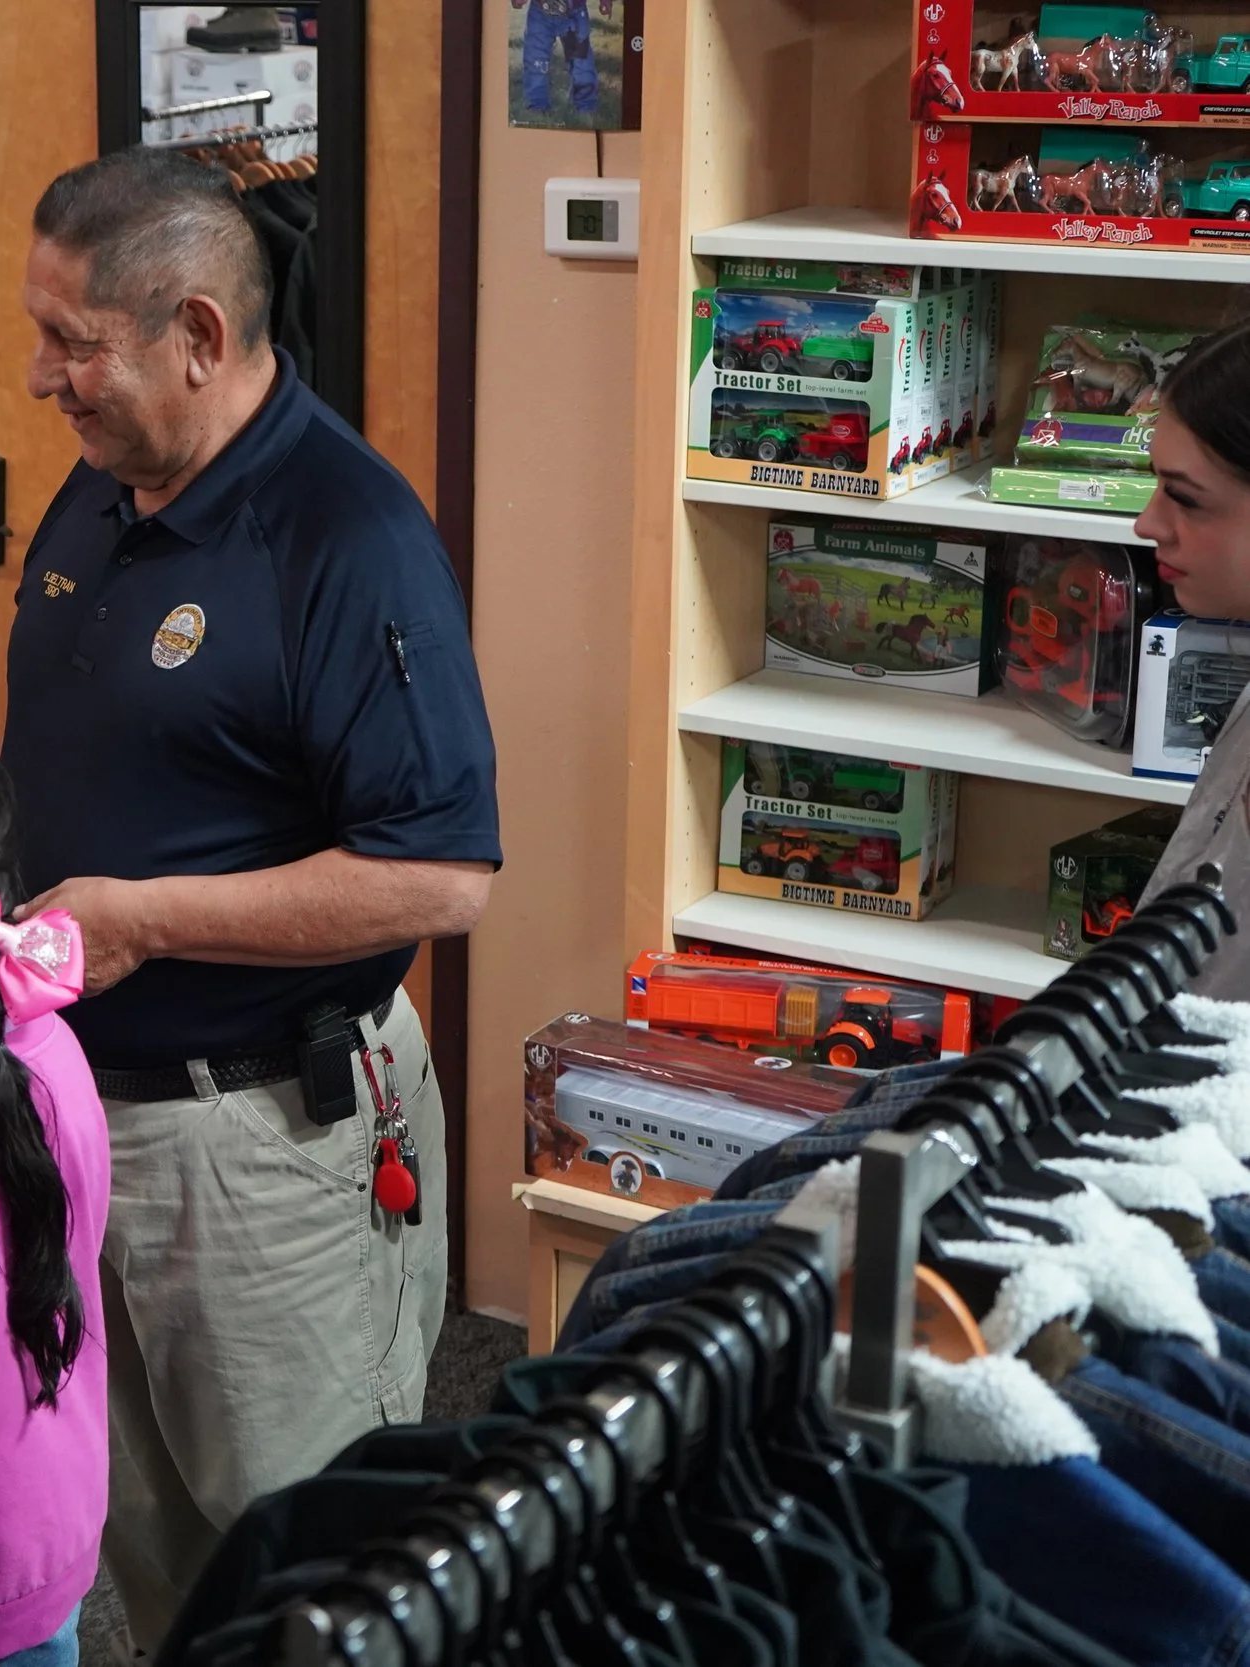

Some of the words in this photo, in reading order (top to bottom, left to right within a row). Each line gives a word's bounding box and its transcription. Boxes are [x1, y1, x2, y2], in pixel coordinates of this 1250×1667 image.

[1058, 96, 1110, 120] Valley
[1109, 98, 1163, 122] Ranch
[1052, 218, 1102, 242] Valley
[1102, 221, 1153, 245] Ranch
[723, 262, 771, 279] Tractor
[775, 265, 797, 280] Set
[924, 330, 933, 385] Tractor
[943, 324, 952, 378] Tractor
[903, 339, 912, 394] Tractor
[714, 371, 771, 390] Tractor
[777, 376, 802, 393] Set
[805, 384, 836, 394] top-level
[838, 386, 854, 395] farm
[750, 465, 803, 486] BIGTIME
[811, 472, 880, 496] BARNYARD
[825, 535, 861, 550] Farm
[864, 540, 926, 557] Animals
[745, 796, 802, 816] Tractor
[807, 804, 832, 820] Set
[781, 884, 834, 905] BIGTIME
[842, 894, 911, 917] BARNYARD
